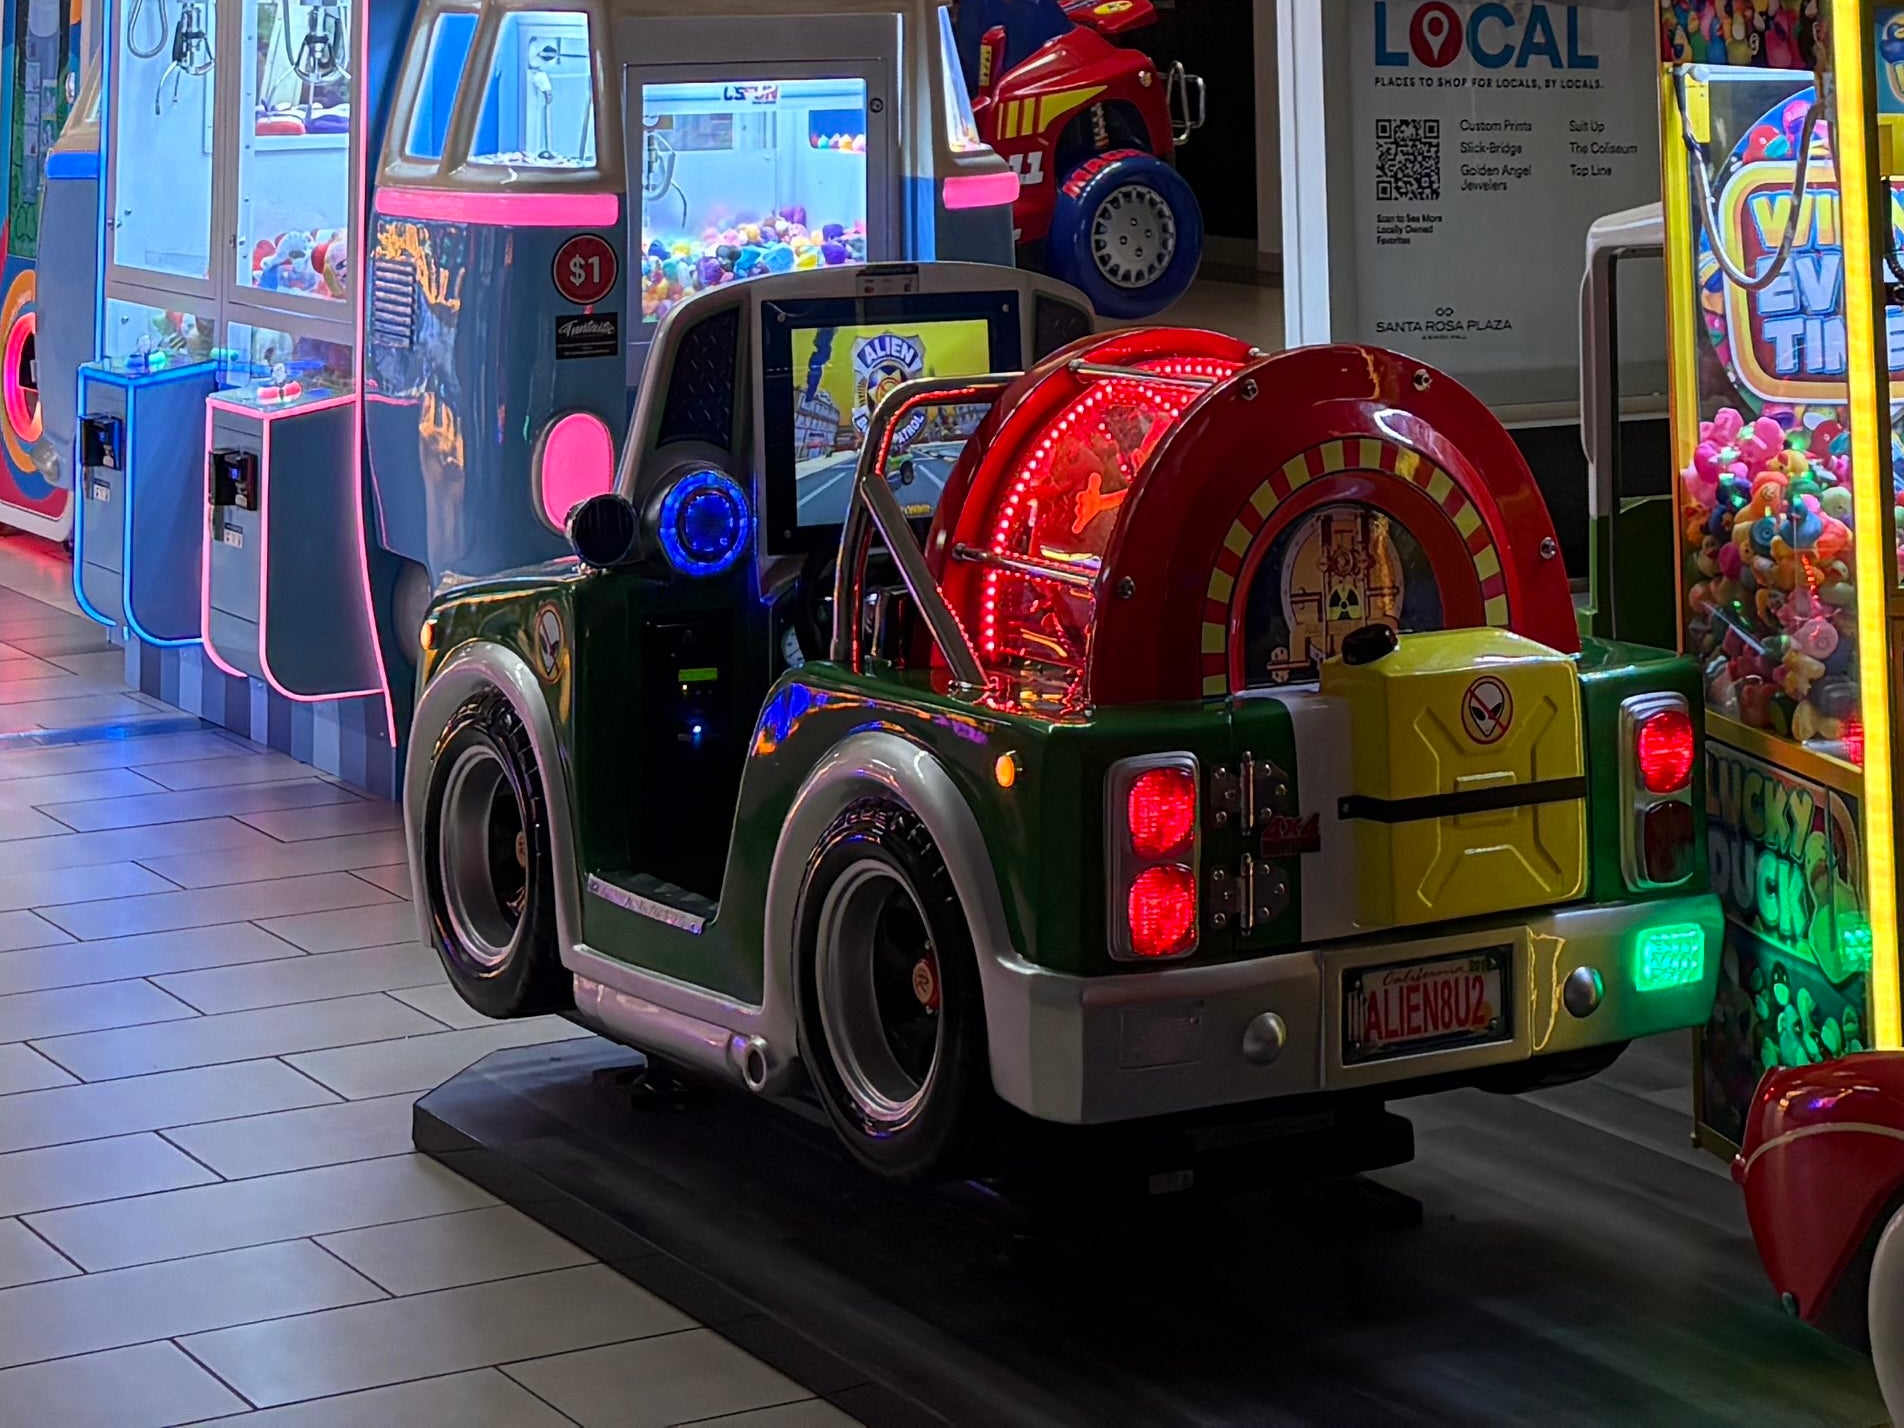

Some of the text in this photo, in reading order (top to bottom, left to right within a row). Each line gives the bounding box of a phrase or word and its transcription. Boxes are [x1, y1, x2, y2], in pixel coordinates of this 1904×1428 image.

[1374, 0, 1599, 69] LOCAL
[1375, 76, 1416, 88] PLACES
[1419, 76, 1434, 88] TO
[1437, 76, 1467, 88] SHOP
[1471, 77, 1494, 88] FOR
[1545, 77, 1558, 89] BY
[1460, 119, 1532, 132] Custom Prints
[1569, 120, 1605, 134] Suit Up
[1570, 142, 1638, 154] The Coliseum
[1460, 164, 1532, 178] Golden Angel
[1570, 164, 1612, 177] Top Line
[1460, 179, 1508, 191] Jewelers
[568, 252, 602, 288] $1
[1376, 319, 1513, 332] SANTA ROSA PLAZA
[863, 334, 915, 364] ALIEN
[1364, 975, 1486, 1045] ALIEN8U2
